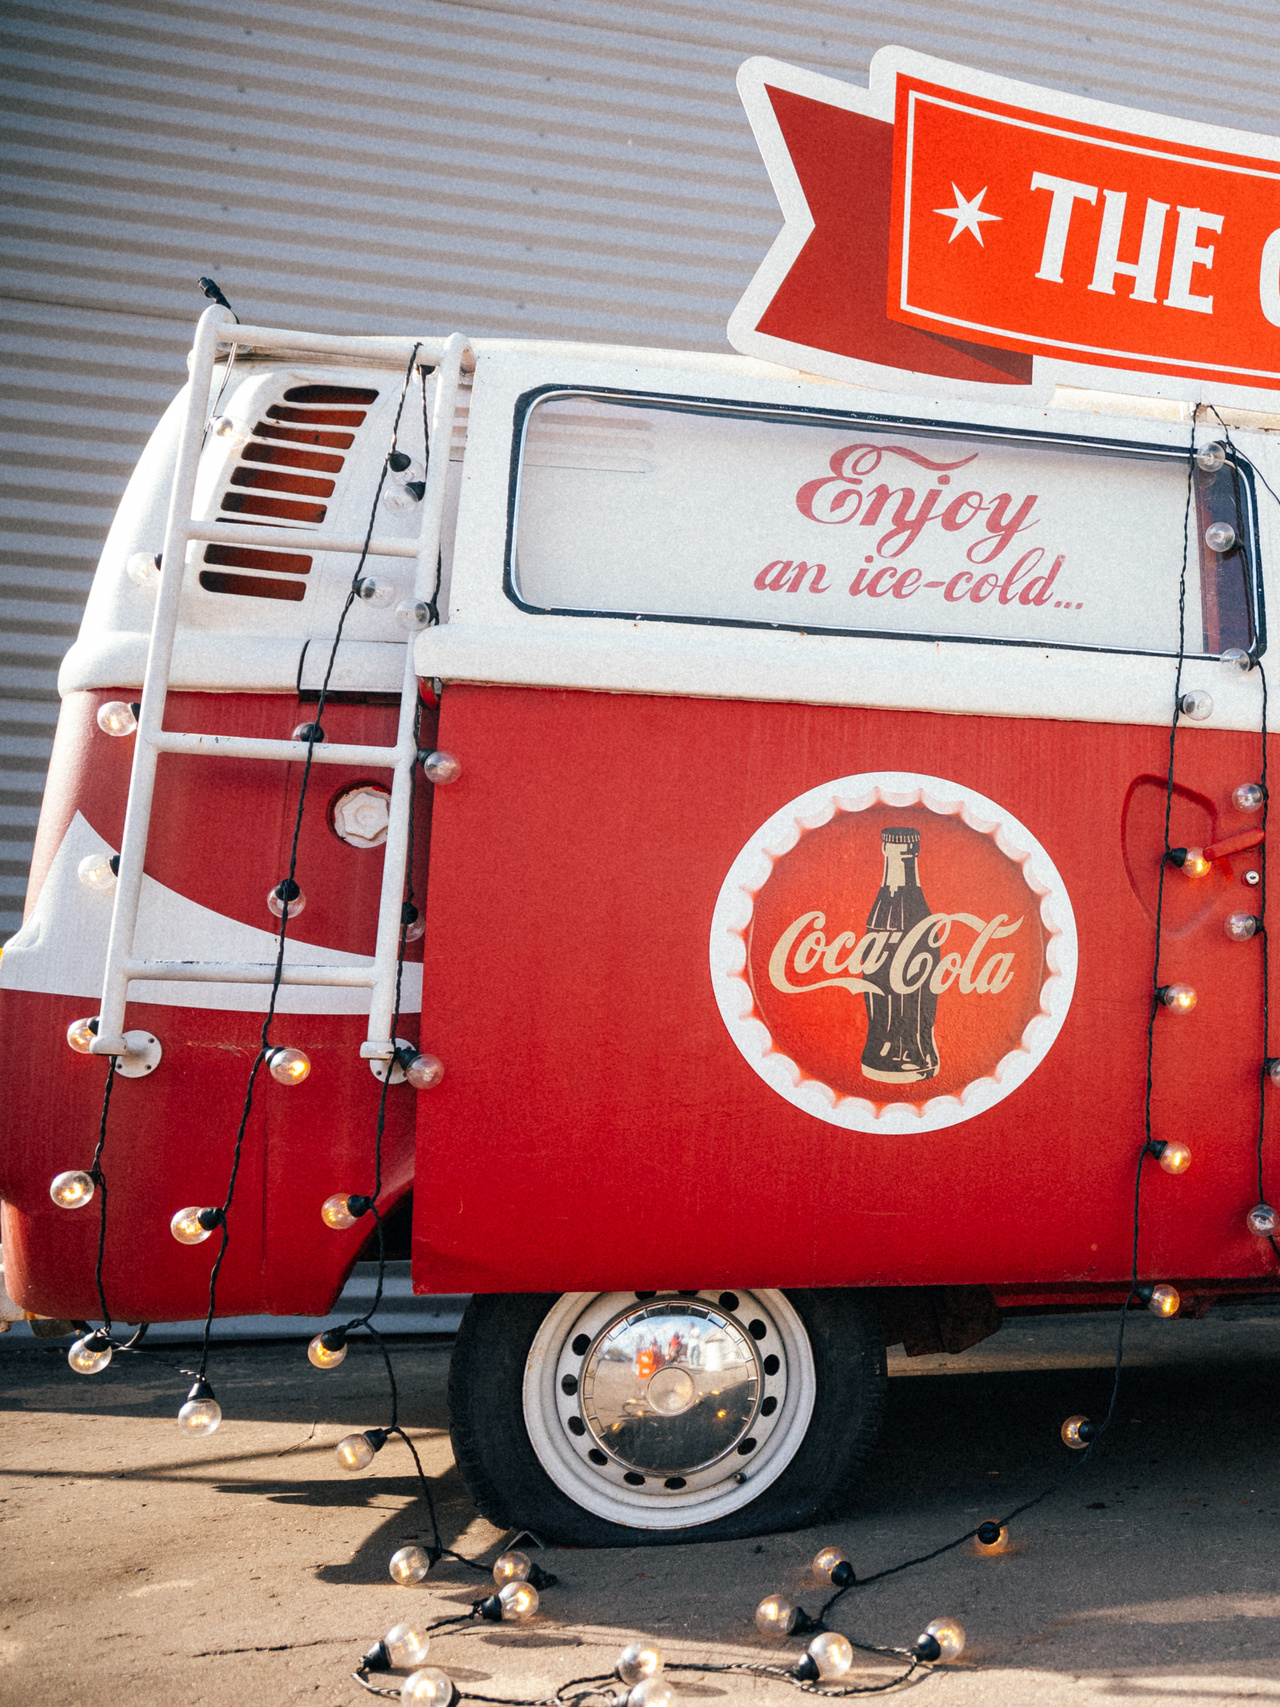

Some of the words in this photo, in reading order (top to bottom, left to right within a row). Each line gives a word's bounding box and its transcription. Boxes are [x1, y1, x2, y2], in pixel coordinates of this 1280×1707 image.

[1029, 171, 1226, 315] THE
[796, 443, 1040, 564] Enjoy
[754, 559, 832, 594] an
[848, 547, 1084, 611] ice-cold...
[768, 910, 1025, 996] Coca-Cola
